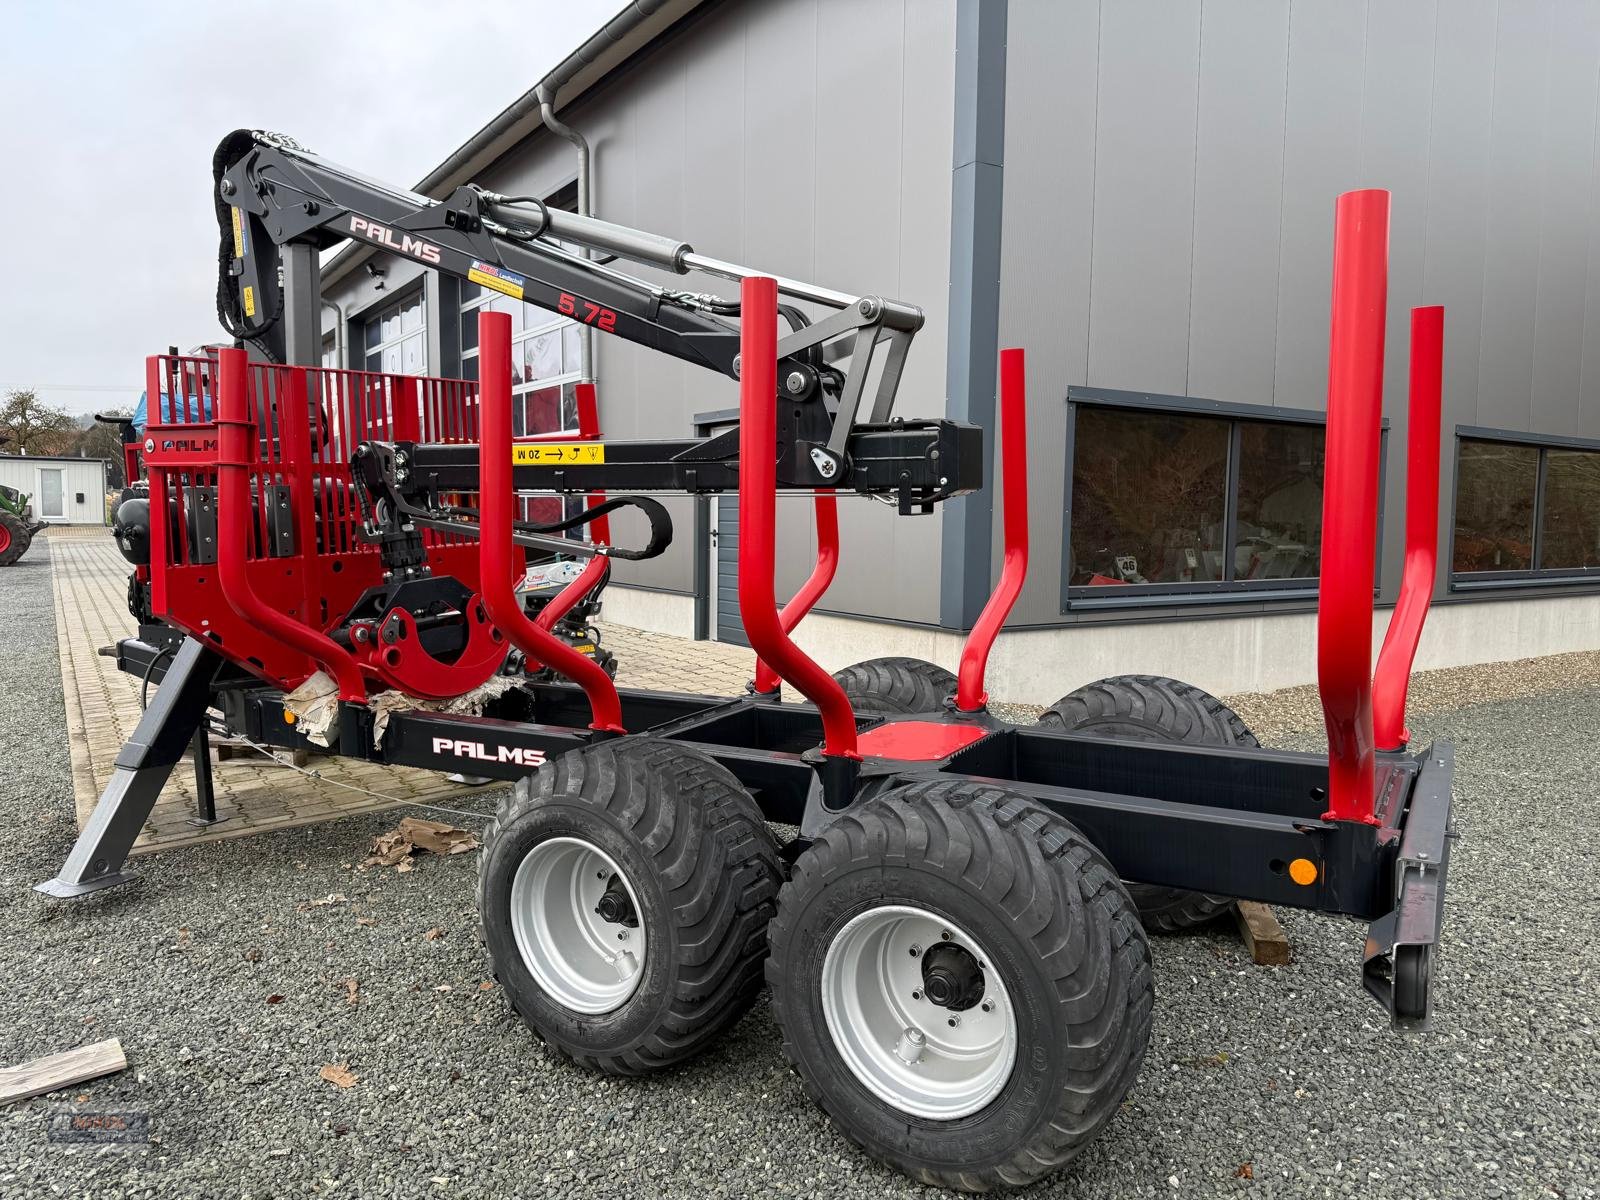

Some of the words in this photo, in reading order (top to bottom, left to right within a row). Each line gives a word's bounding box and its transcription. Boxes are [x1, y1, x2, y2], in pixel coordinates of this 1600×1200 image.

[349, 215, 441, 264] PALMS
[558, 292, 617, 333] 5.72
[161, 439, 219, 453] PALM
[517, 449, 527, 460] M
[528, 449, 541, 460] 20
[1122, 561, 1135, 571] 46
[432, 736, 547, 767] PALMS
